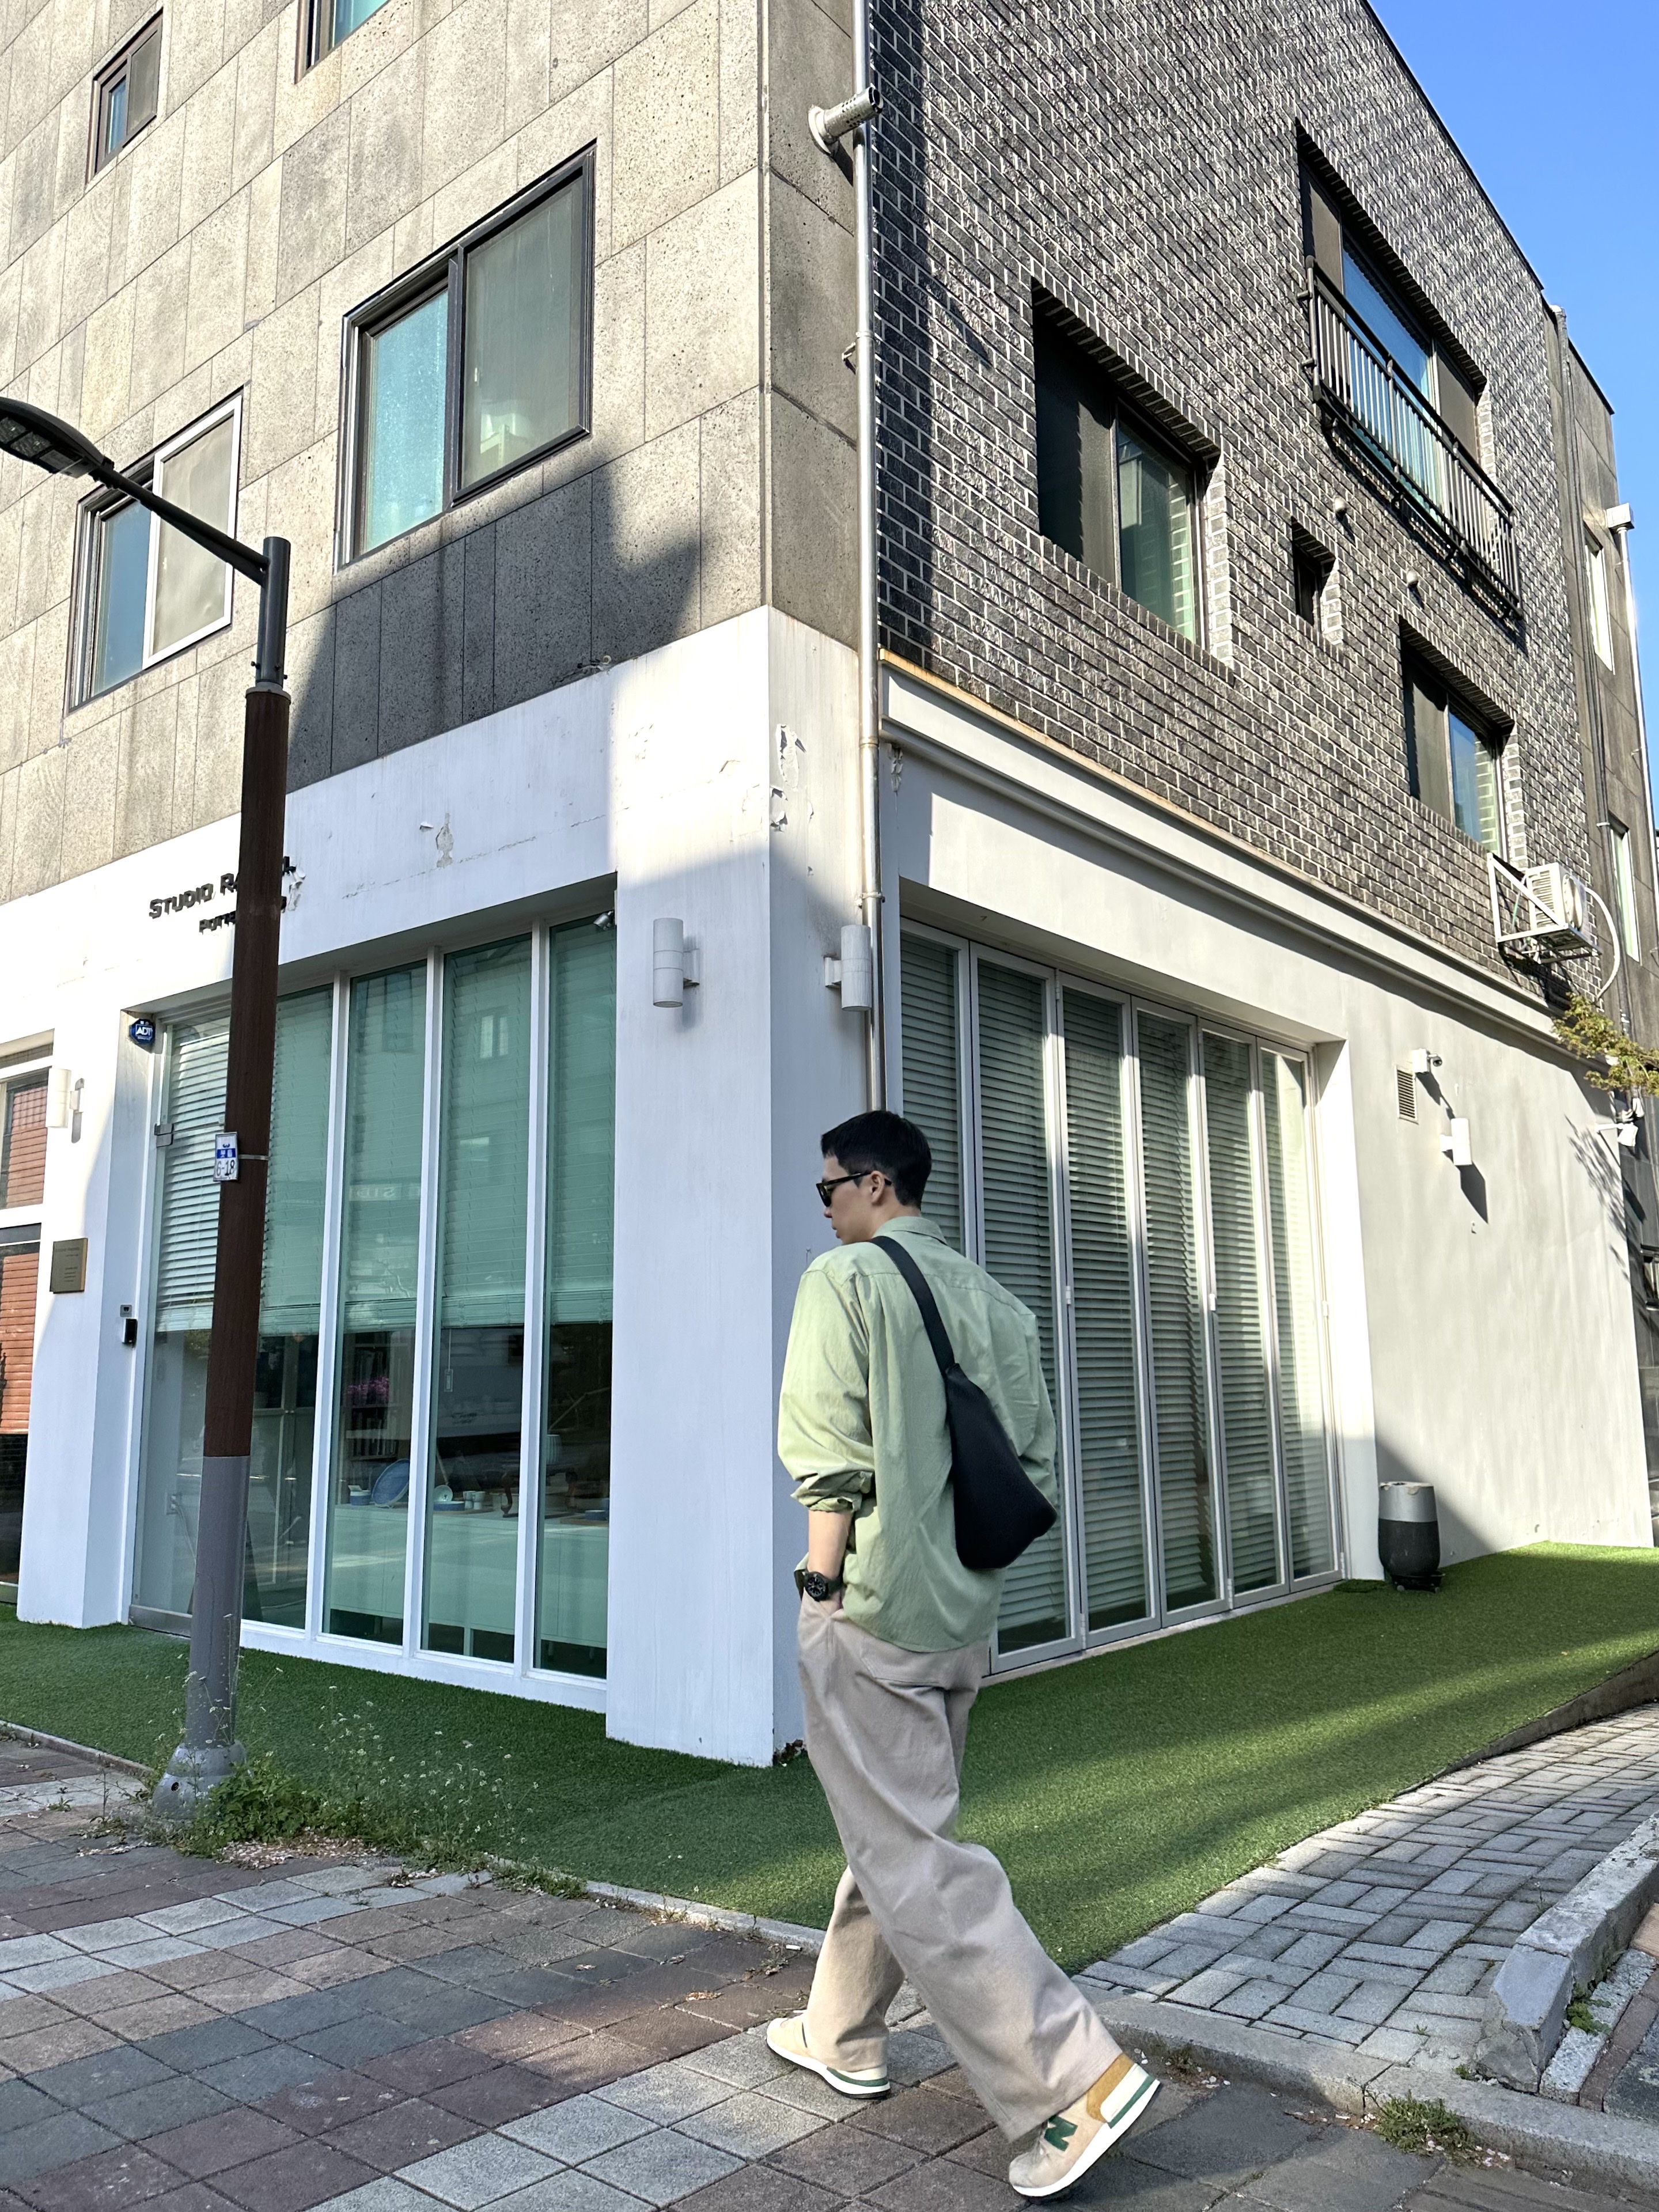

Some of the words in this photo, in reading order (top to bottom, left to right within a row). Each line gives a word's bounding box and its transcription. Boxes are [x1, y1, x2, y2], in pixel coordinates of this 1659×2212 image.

[149, 883, 214, 919] STUDIO
[136, 1027, 153, 1036] ADT
[1044, 2115, 1078, 2152] N
